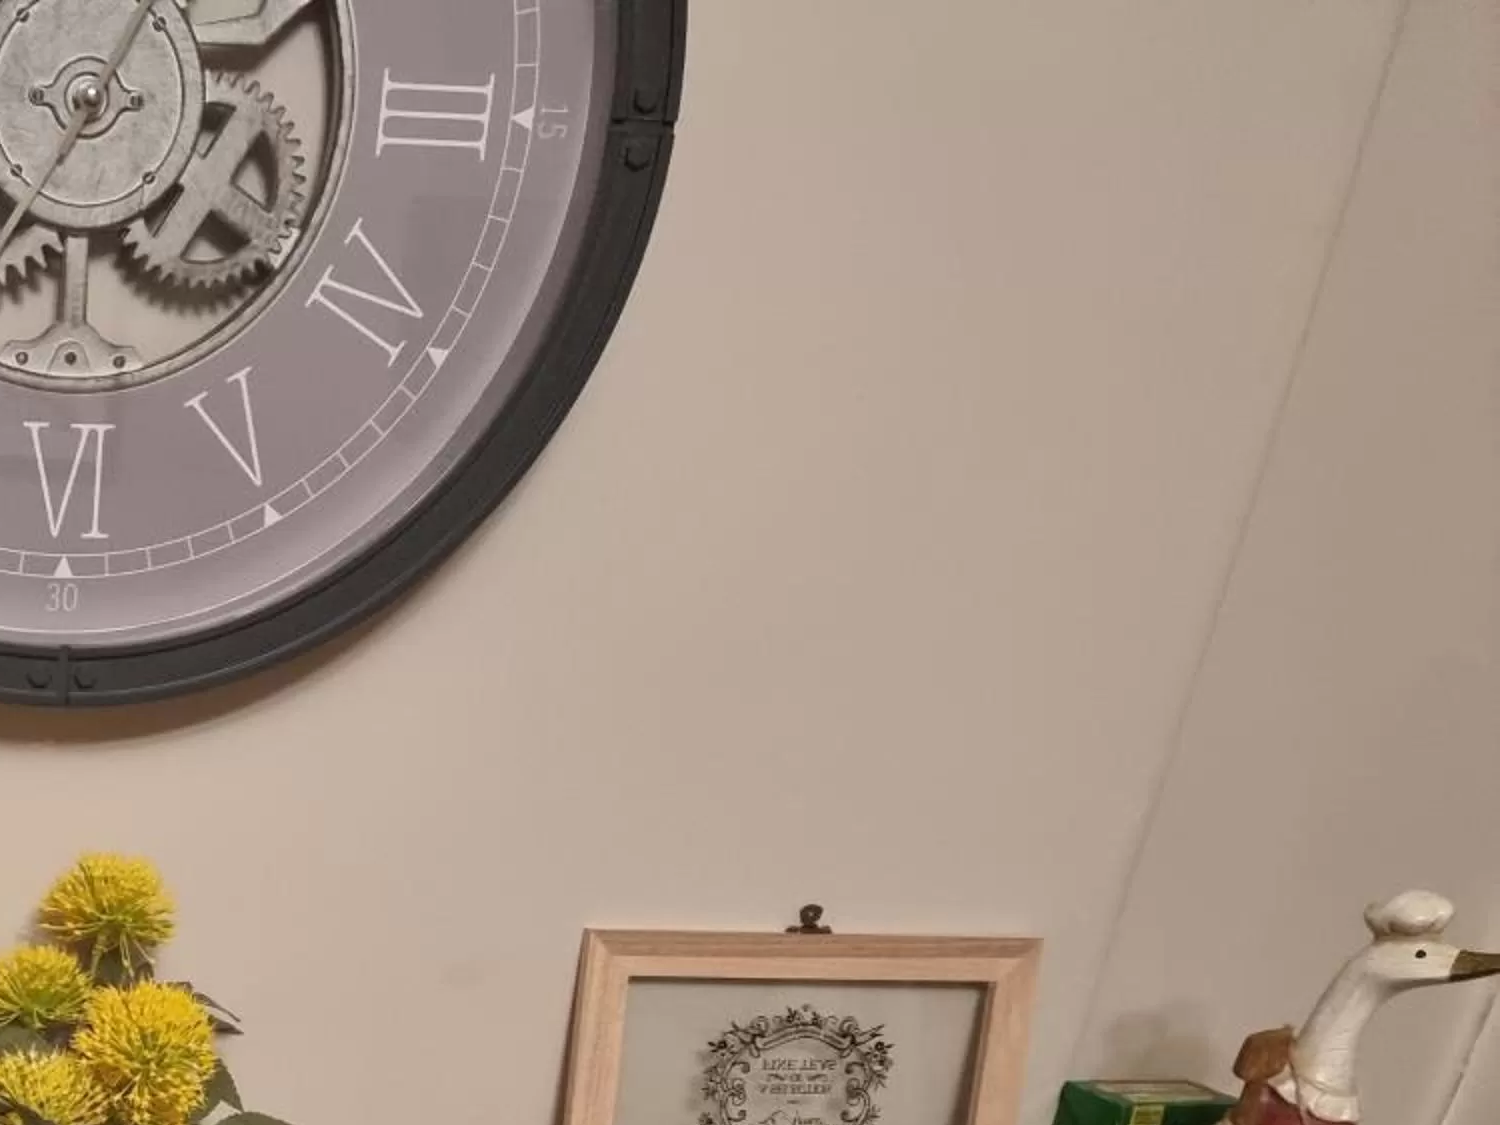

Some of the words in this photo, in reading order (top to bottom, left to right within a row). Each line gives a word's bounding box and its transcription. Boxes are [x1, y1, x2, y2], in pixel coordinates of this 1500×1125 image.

[375, 67, 496, 162] III
[537, 104, 570, 139] 15
[304, 216, 424, 368] IV
[184, 366, 263, 487] V
[23, 421, 116, 539] VI
[45, 583, 80, 613] 30
